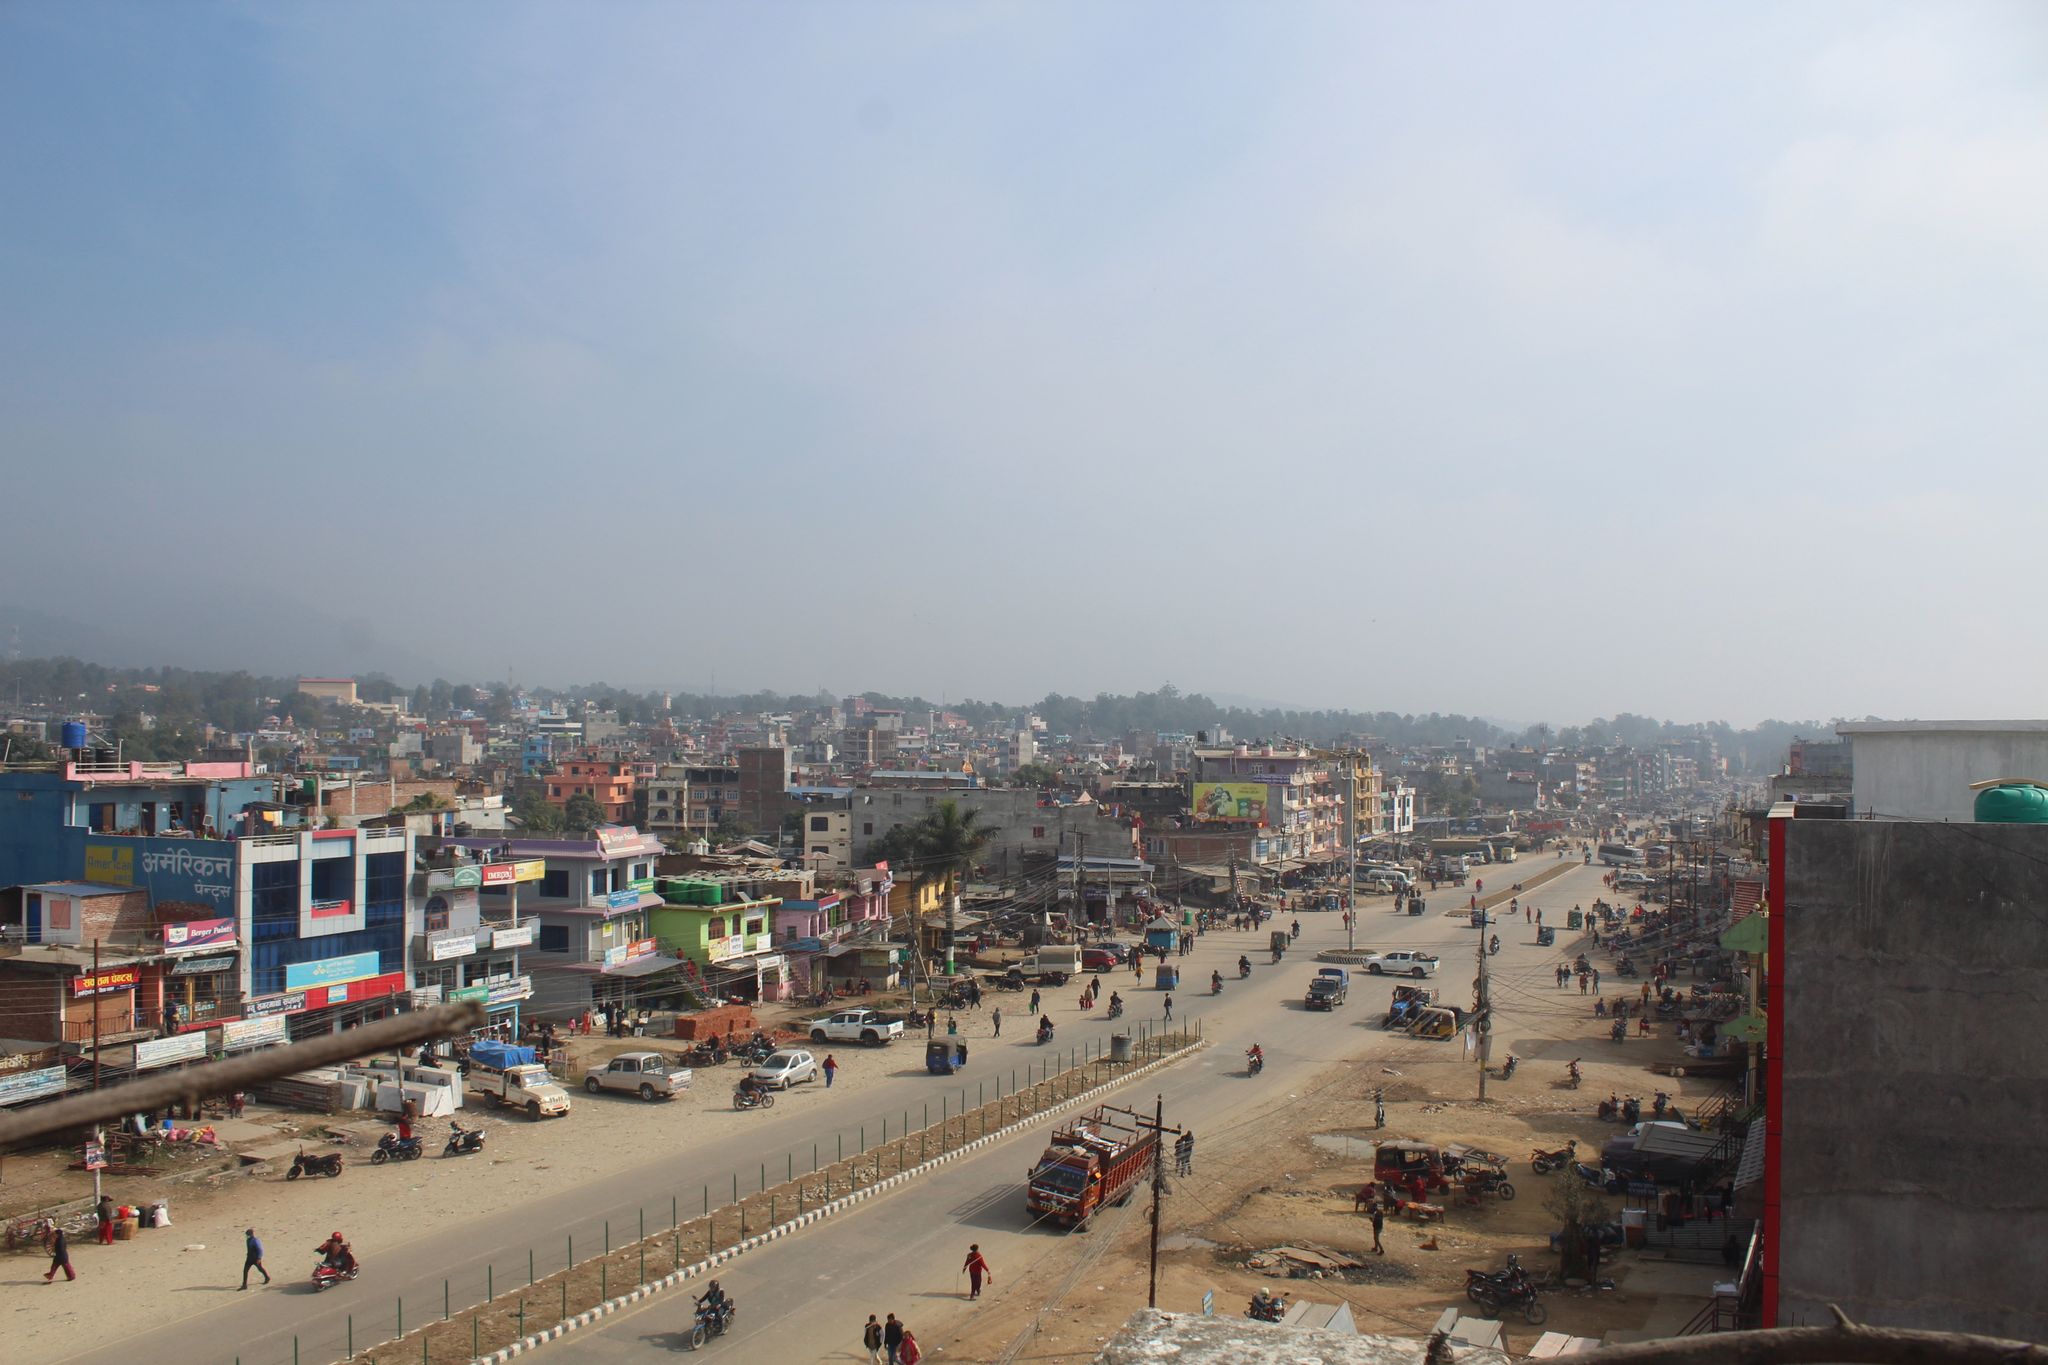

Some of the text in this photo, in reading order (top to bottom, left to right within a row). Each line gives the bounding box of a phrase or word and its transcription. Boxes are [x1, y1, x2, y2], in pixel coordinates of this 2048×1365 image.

[142, 847, 233, 879] अमेरिकन
[191, 926, 233, 937] Berger Paints
